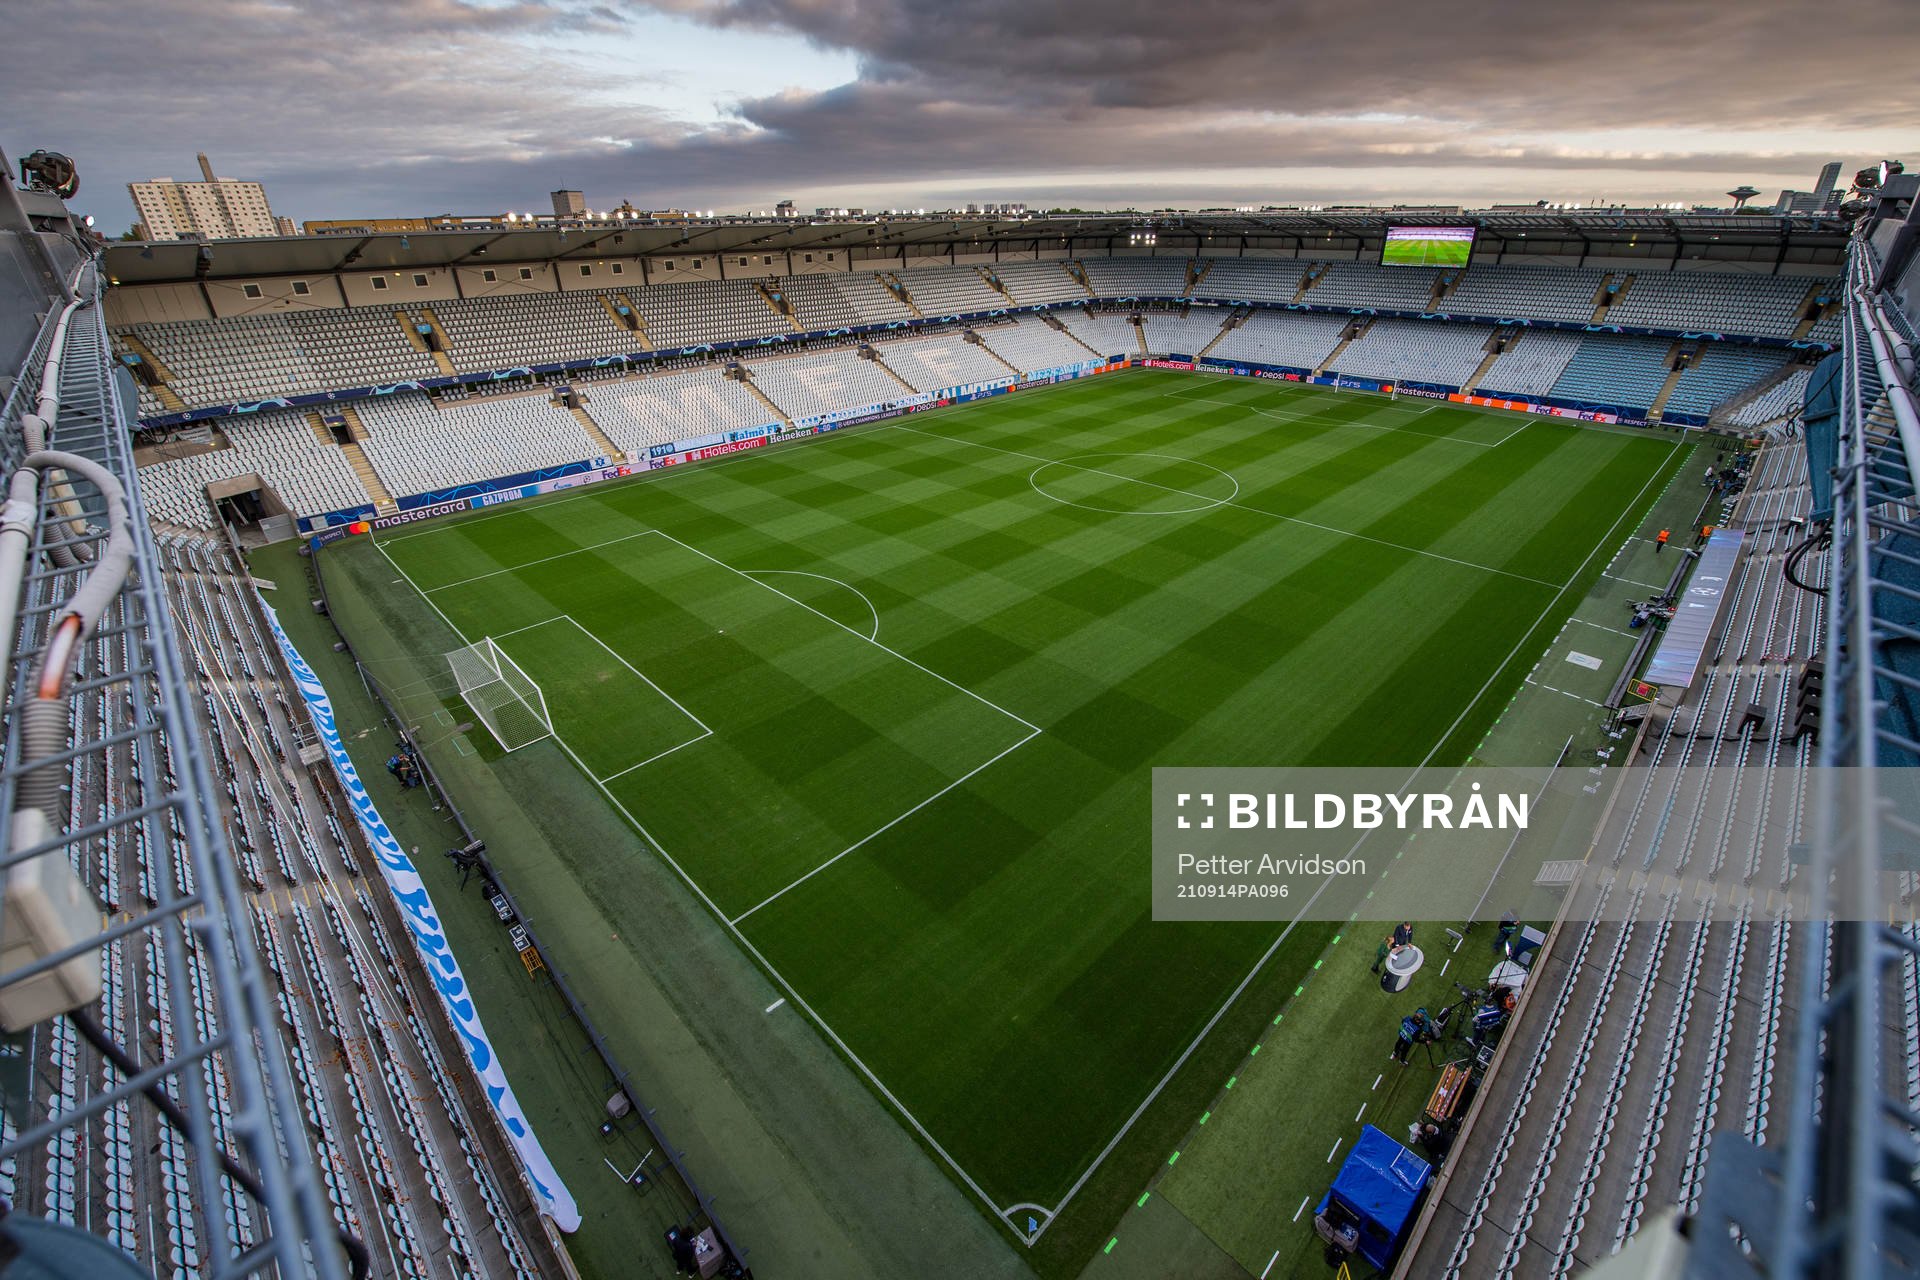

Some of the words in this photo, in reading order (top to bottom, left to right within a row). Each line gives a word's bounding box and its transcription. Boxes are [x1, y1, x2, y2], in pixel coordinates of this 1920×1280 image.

[1152, 360, 1191, 371] Hotels.com
[1195, 363, 1228, 375] Heineken
[1262, 371, 1284, 381] pepsi
[1016, 377, 1049, 391] mastercard
[1395, 386, 1446, 400] mastercard
[916, 401, 937, 413] pepsi
[1535, 404, 1562, 417] FedEx
[1578, 411, 1607, 423] FedEx
[1623, 418, 1648, 427] RESPECT
[729, 427, 765, 442] Malmö
[770, 426, 812, 444] Heineken
[703, 437, 760, 458] Hotels.com
[650, 456, 677, 470] FedEx
[602, 465, 632, 480] FedEx
[482, 488, 523, 506] GAZPROM
[374, 500, 466, 529] mastercard
